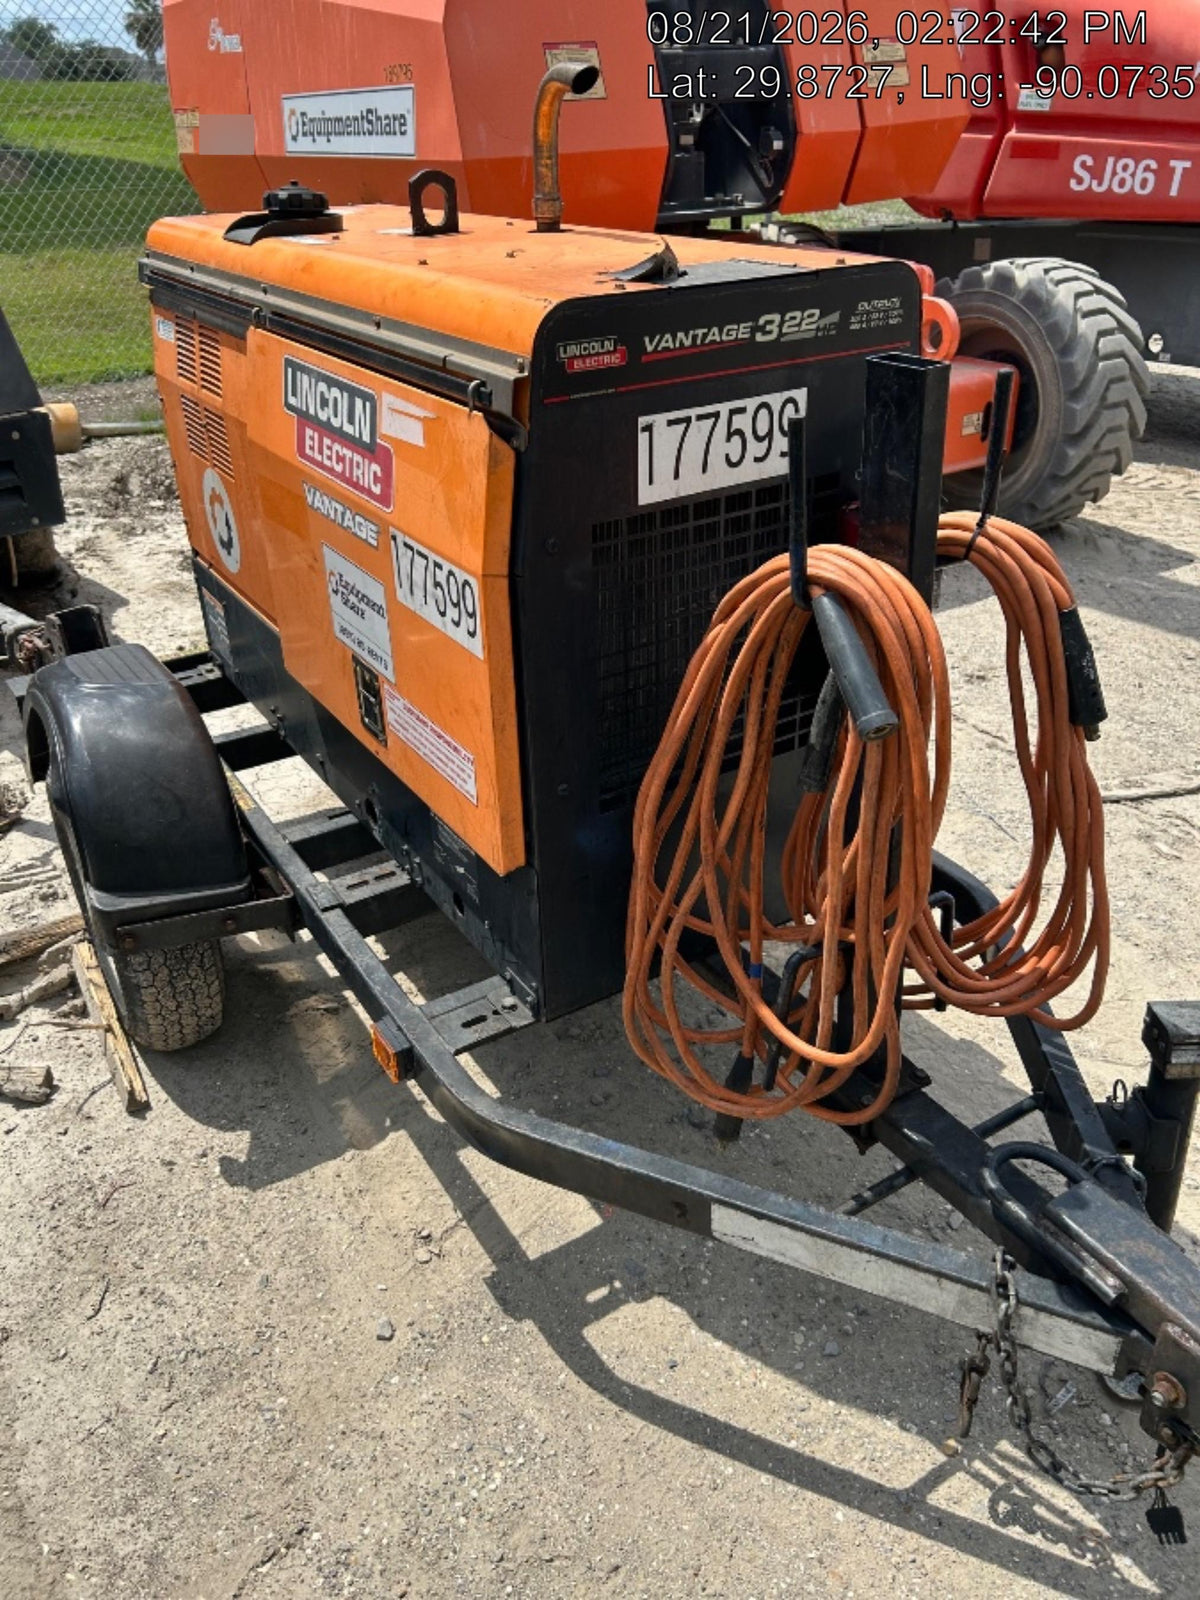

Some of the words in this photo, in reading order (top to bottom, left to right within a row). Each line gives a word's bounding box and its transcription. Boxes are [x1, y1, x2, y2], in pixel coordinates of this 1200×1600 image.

[300, 107, 408, 143] EquipmentShare
[1069, 154, 1157, 196] SJ86
[1168, 159, 1192, 197] T
[559, 338, 614, 359] LINCOLN
[643, 321, 752, 353] VANTAGE
[755, 308, 821, 342] 322
[573, 353, 622, 369] ELECTRIC
[287, 366, 371, 444] LINCOLN
[304, 425, 382, 496] ELECTRIC
[640, 396, 800, 486] 177599
[303, 482, 380, 548] VANTAGE
[391, 534, 478, 639] 177599
